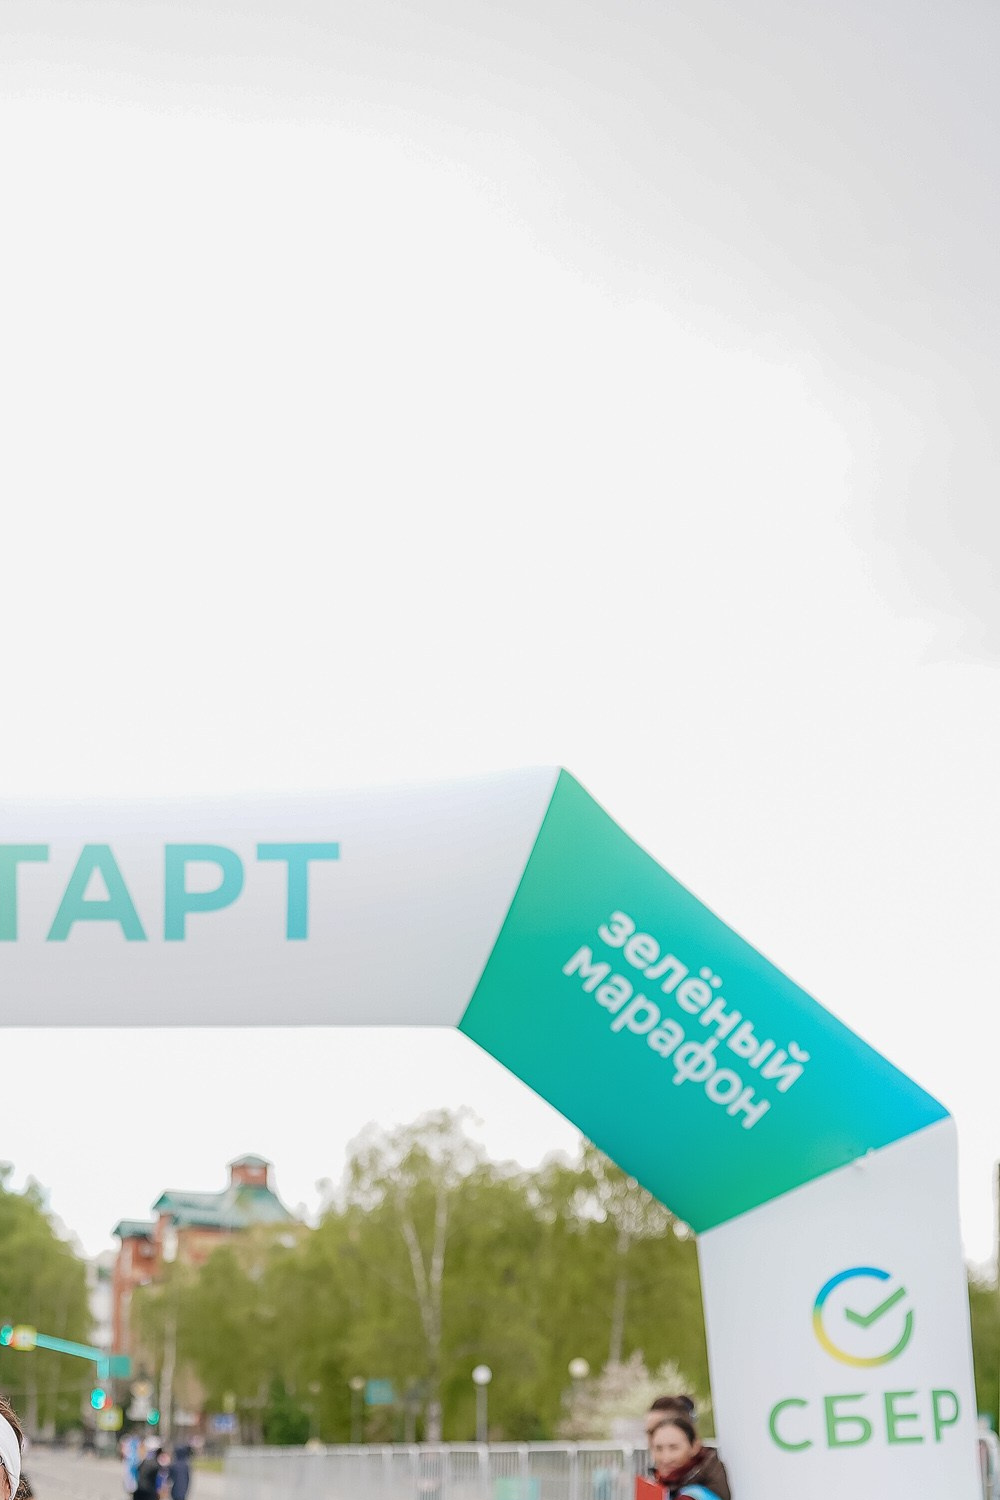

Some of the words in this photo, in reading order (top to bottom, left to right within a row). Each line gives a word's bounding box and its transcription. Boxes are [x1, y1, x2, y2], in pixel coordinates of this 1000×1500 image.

[562, 946, 771, 1129] марафон
[598, 910, 810, 1093] зелёный
[768, 1389, 960, 1452] СБЕР
